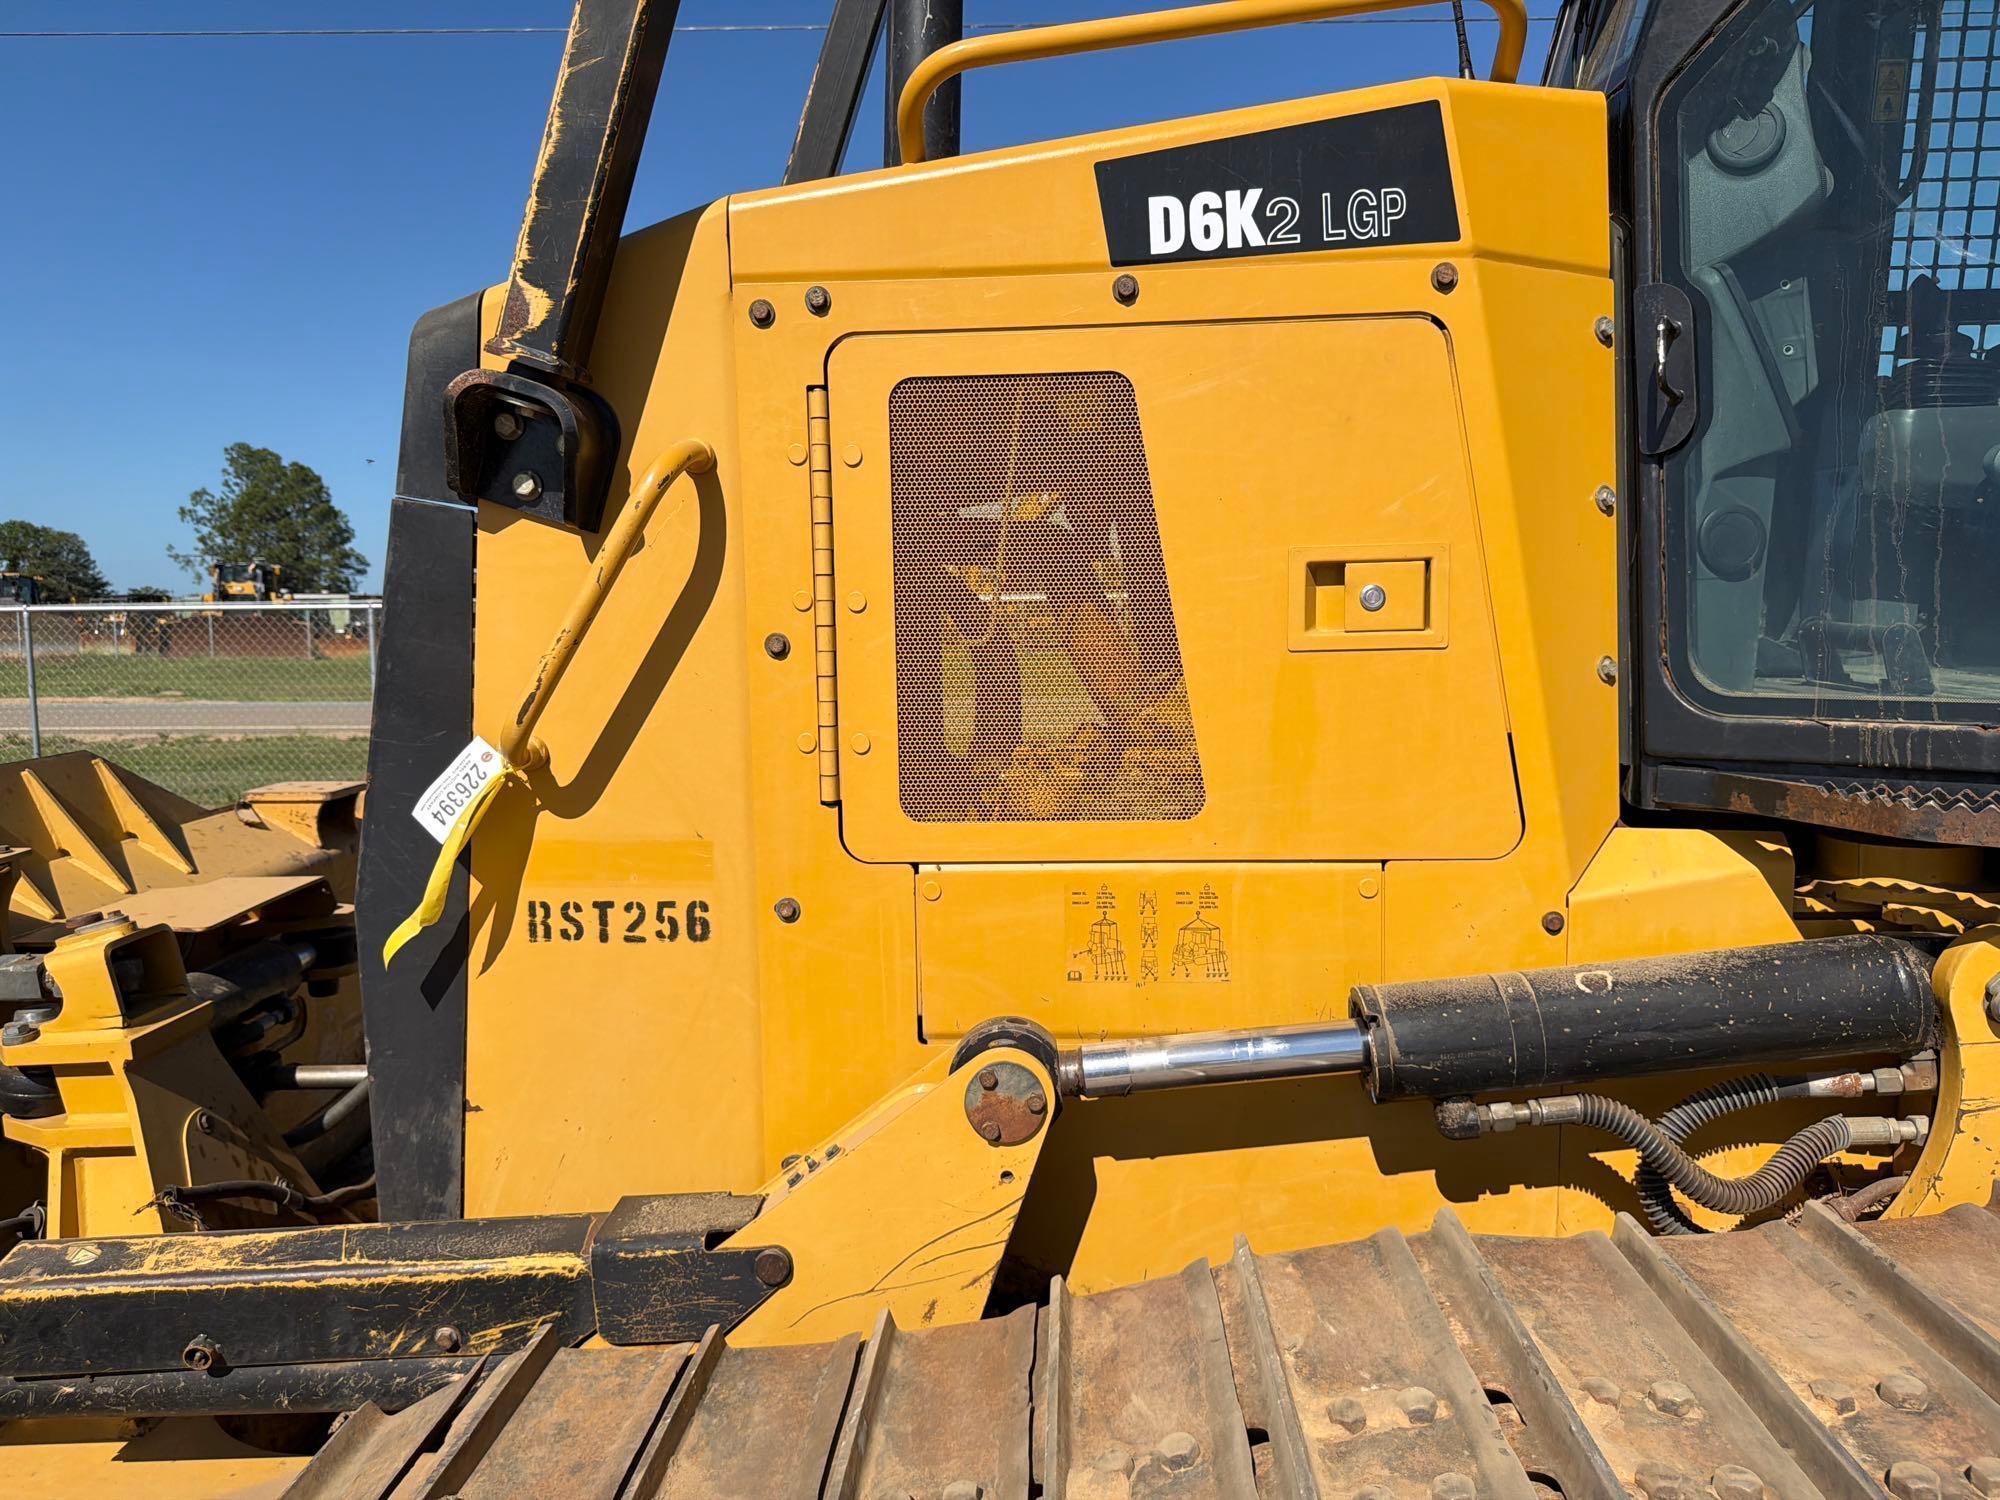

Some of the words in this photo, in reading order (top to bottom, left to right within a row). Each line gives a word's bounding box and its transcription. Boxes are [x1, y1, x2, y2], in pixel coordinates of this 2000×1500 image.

[1148, 188, 1300, 254] D6K2
[1322, 188, 1406, 241] LGP
[431, 763, 487, 826] 226394
[528, 900, 711, 943] RST256
